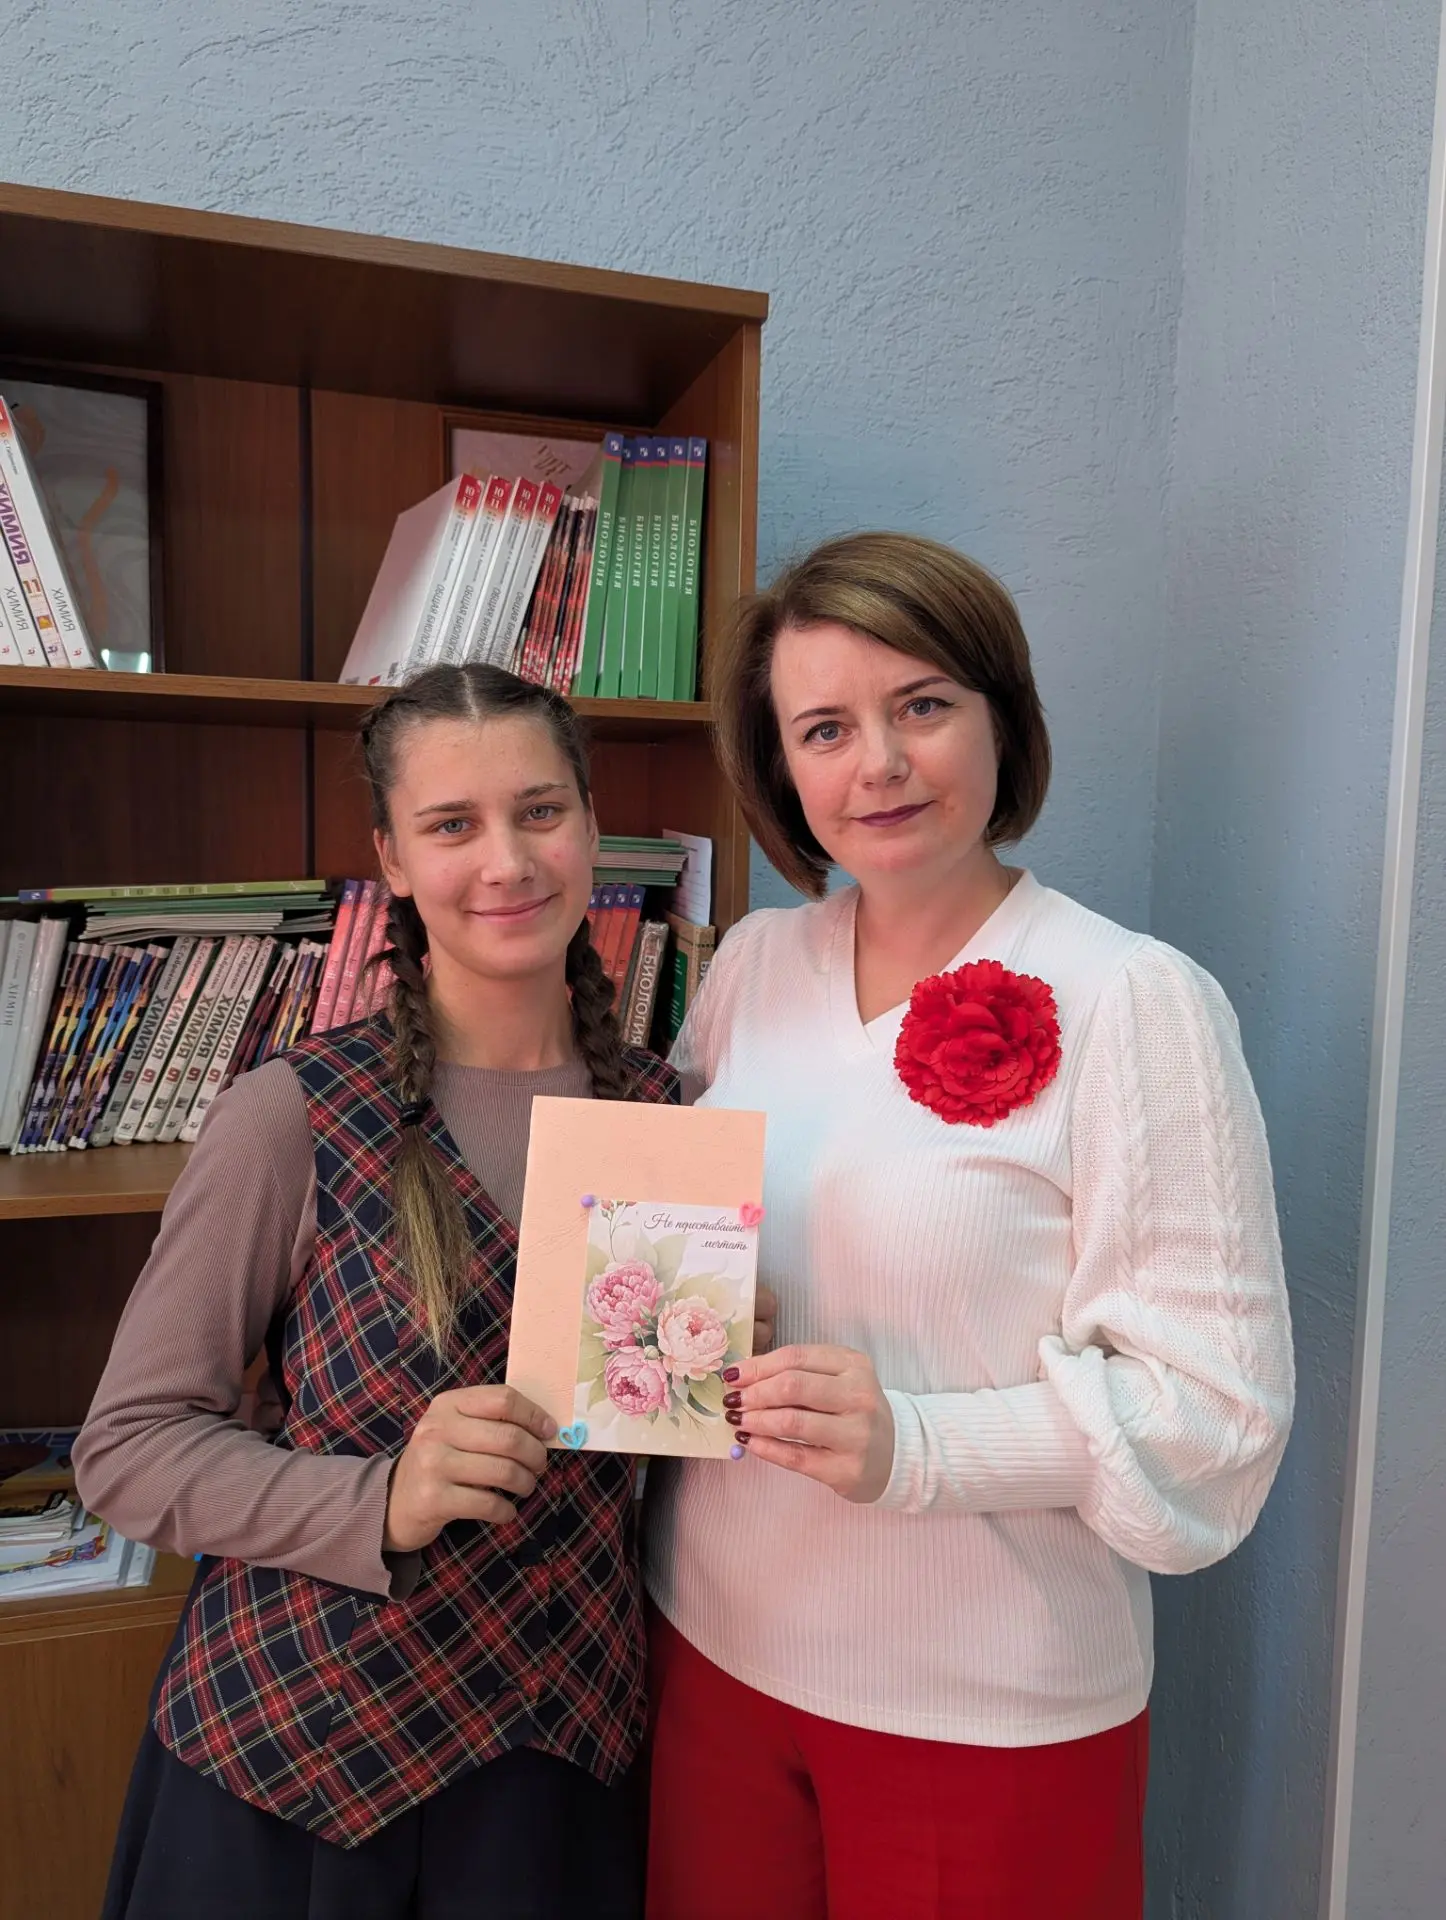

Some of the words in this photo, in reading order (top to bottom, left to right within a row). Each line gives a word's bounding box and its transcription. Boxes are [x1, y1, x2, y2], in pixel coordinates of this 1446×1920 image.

[460, 496, 471, 508] 11
[464, 484, 475, 496] 10
[488, 497, 501, 509] 11
[492, 486, 505, 498] 10
[516, 499, 528, 511] 11
[520, 488, 531, 499] 10
[544, 492, 555, 504] 10
[540, 504, 551, 516] 11
[0, 480, 30, 566] ХИМИЯ
[22, 576, 42, 596] 11
[595, 511, 611, 586] БИОЛОГИЯ
[613, 516, 626, 588] БИОЛОГИЯ
[631, 514, 644, 587] БИОЛОГИЯ
[650, 514, 662, 586] БИОЛОГИЯ
[667, 514, 679, 588] БИОЛОГИЯ
[684, 518, 697, 595] БИОЛОГИЯ
[3, 585, 28, 631] ХИМИЯ
[50, 586, 75, 632] ХИМИЯ
[429, 583, 444, 614] ОБЩАЯ
[457, 584, 474, 615] ОБЩАЯ
[485, 586, 501, 617] ОБЩАЯ
[508, 591, 525, 622] ОБЩАЯ
[415, 614, 435, 658] БИОЛОГИЯ
[444, 615, 465, 660] БИОЛОГИЯ
[1, 981, 19, 1026] ХИМИЯ
[629, 954, 656, 1045] БИОЛОГИЯ
[129, 993, 167, 1062] ХИМИЯ
[150, 993, 188, 1061] ХИМИЯ
[176, 992, 213, 1060] ХИМИЯ
[195, 992, 233, 1060] ХИМИЯ
[216, 994, 251, 1060] ХИМИЯ
[120, 1068, 135, 1086] 9
[140, 1066, 157, 1085] 9
[164, 1065, 181, 1084] 9
[185, 1065, 202, 1083] 9
[205, 1066, 221, 1084] 9
[644, 1212, 673, 1230] Не
[701, 1239, 749, 1252] мечтать
